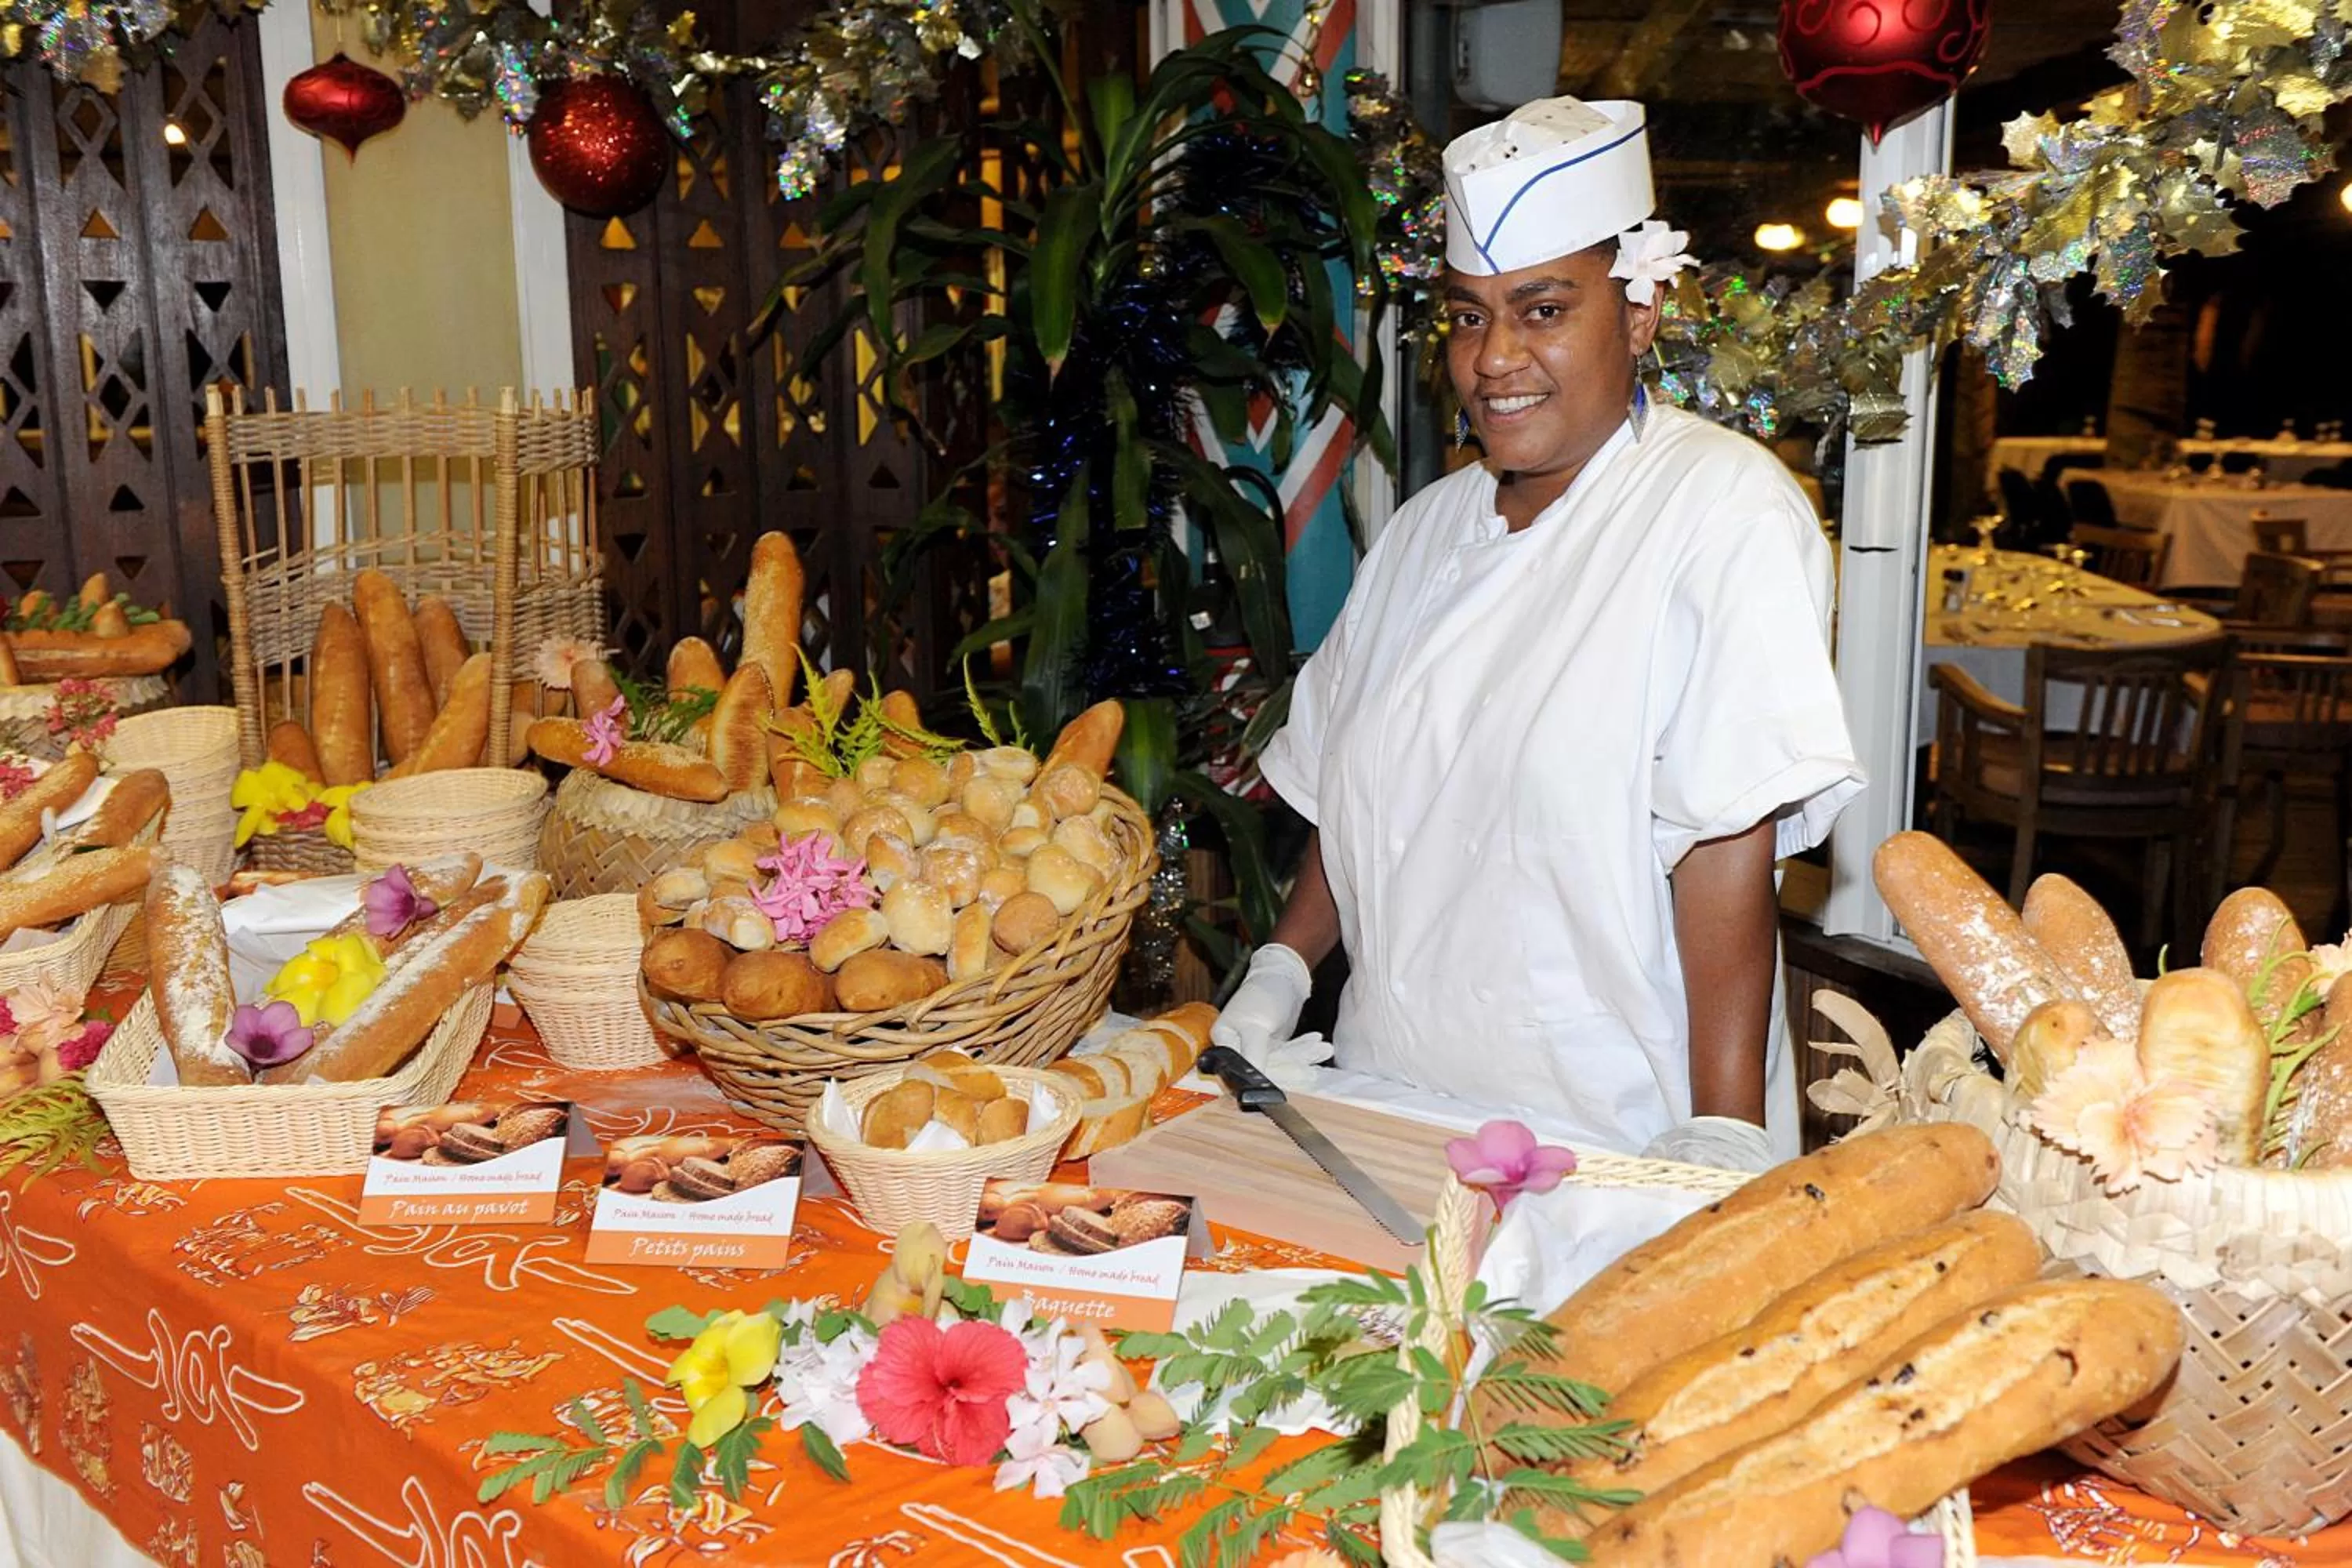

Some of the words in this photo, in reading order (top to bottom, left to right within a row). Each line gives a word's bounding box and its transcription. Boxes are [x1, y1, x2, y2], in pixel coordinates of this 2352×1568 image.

[390, 1200, 437, 1218] Pain
[441, 1202, 469, 1215] au
[470, 1199, 528, 1222] pavot
[629, 1236, 687, 1258] Petits
[688, 1239, 745, 1264] pains
